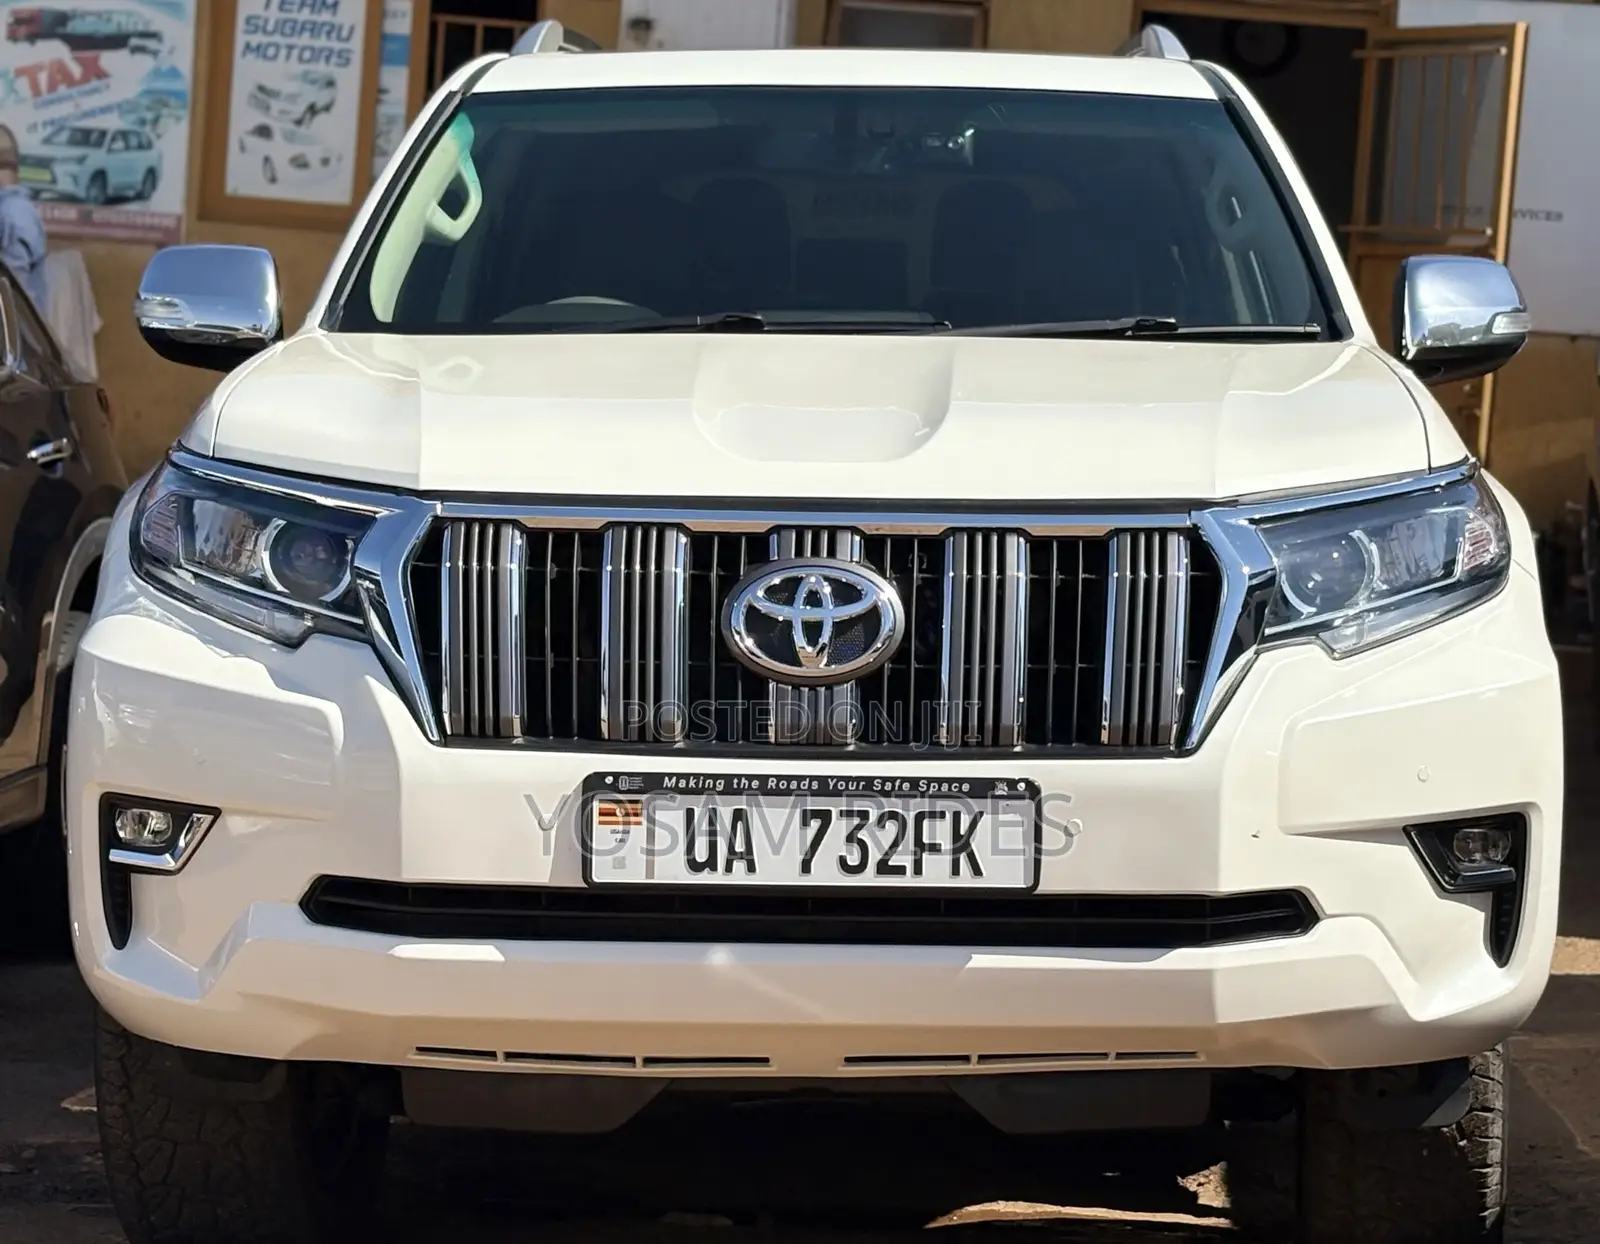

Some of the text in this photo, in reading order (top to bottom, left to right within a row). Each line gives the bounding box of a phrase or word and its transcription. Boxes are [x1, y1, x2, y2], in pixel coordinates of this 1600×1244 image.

[264, 0, 340, 17] TEAM
[243, 14, 356, 43] SUBARU
[241, 41, 355, 68] MOTORS
[14, 53, 111, 98] TAX
[663, 776, 971, 794] Making the Roads Your Safe Space
[684, 806, 985, 878] UA 732FK
